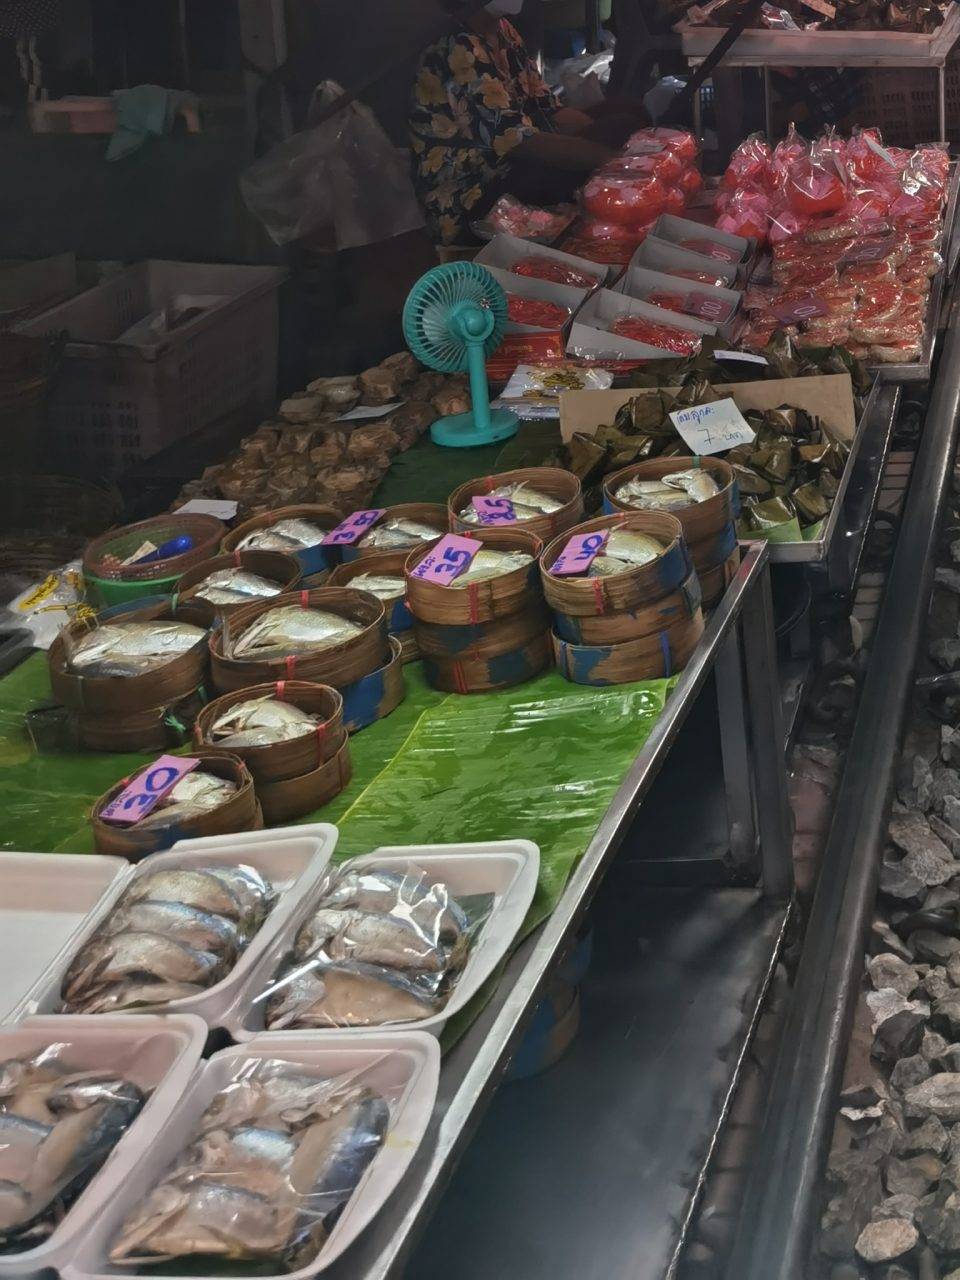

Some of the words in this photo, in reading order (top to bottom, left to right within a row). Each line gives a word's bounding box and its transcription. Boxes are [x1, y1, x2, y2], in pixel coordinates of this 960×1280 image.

[434, 546, 472, 577] 35
[574, 534, 603, 560] 40
[123, 766, 180, 814] 30
